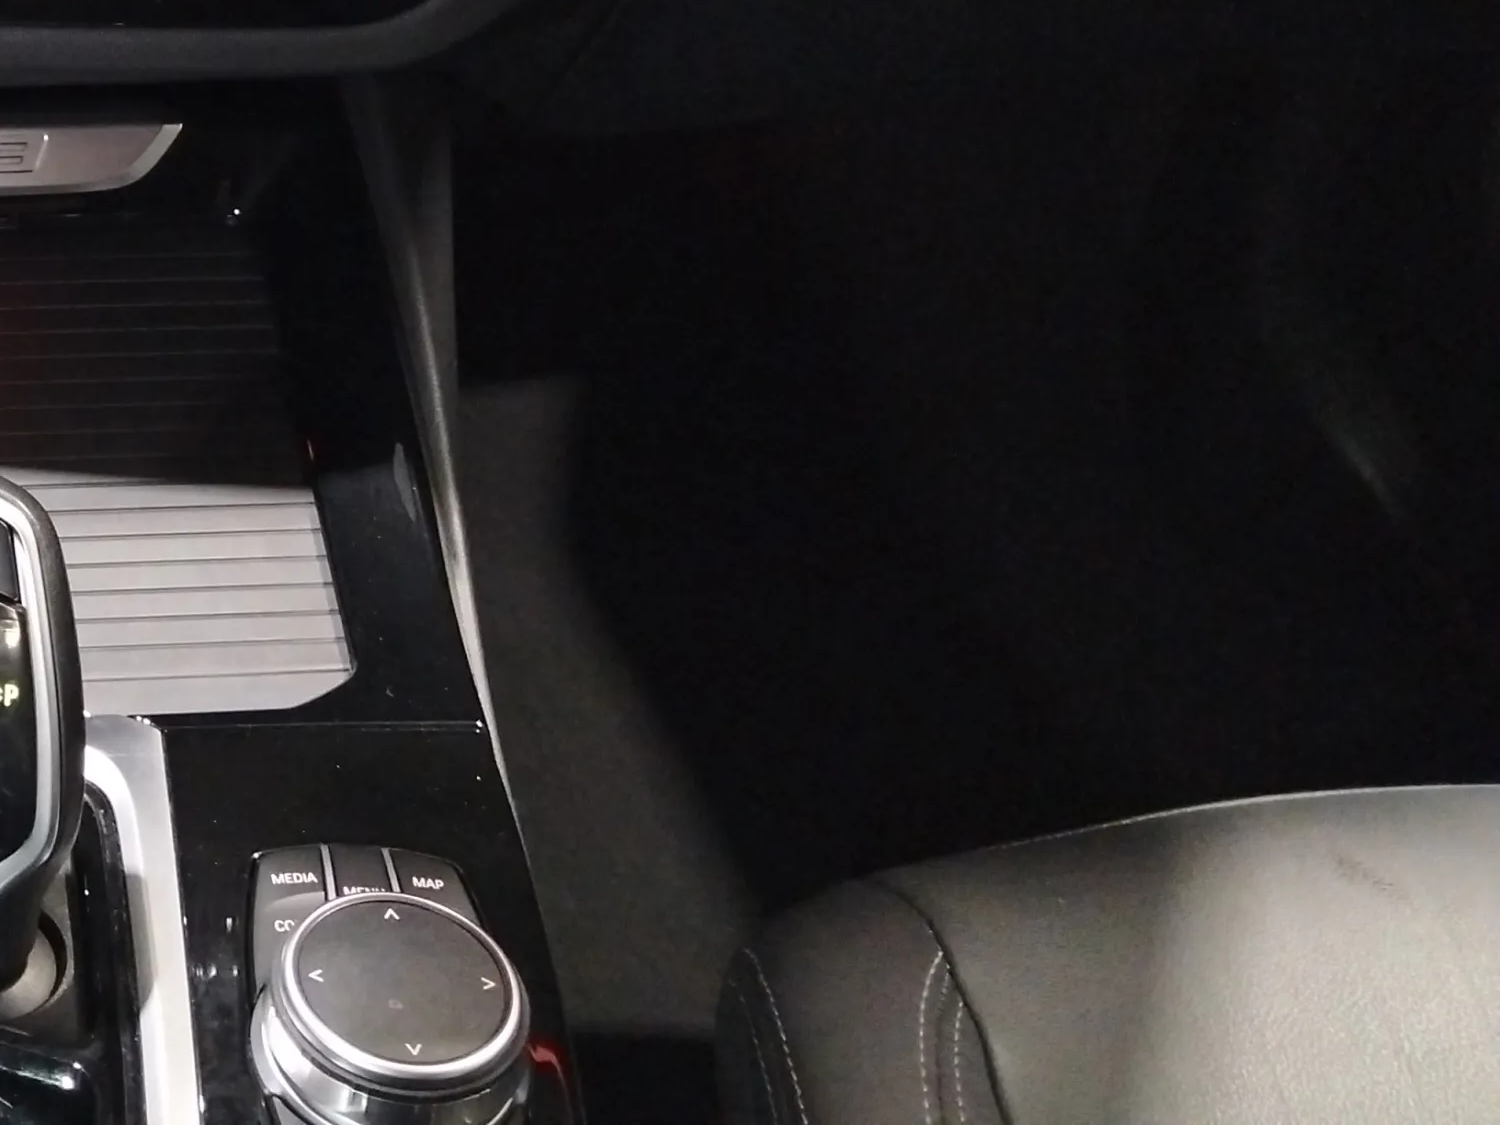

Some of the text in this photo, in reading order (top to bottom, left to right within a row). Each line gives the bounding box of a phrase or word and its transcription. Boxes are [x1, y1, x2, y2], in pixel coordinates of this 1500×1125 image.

[3, 683, 20, 707] P
[270, 871, 318, 886] MEDIA
[412, 876, 445, 890] MAP
